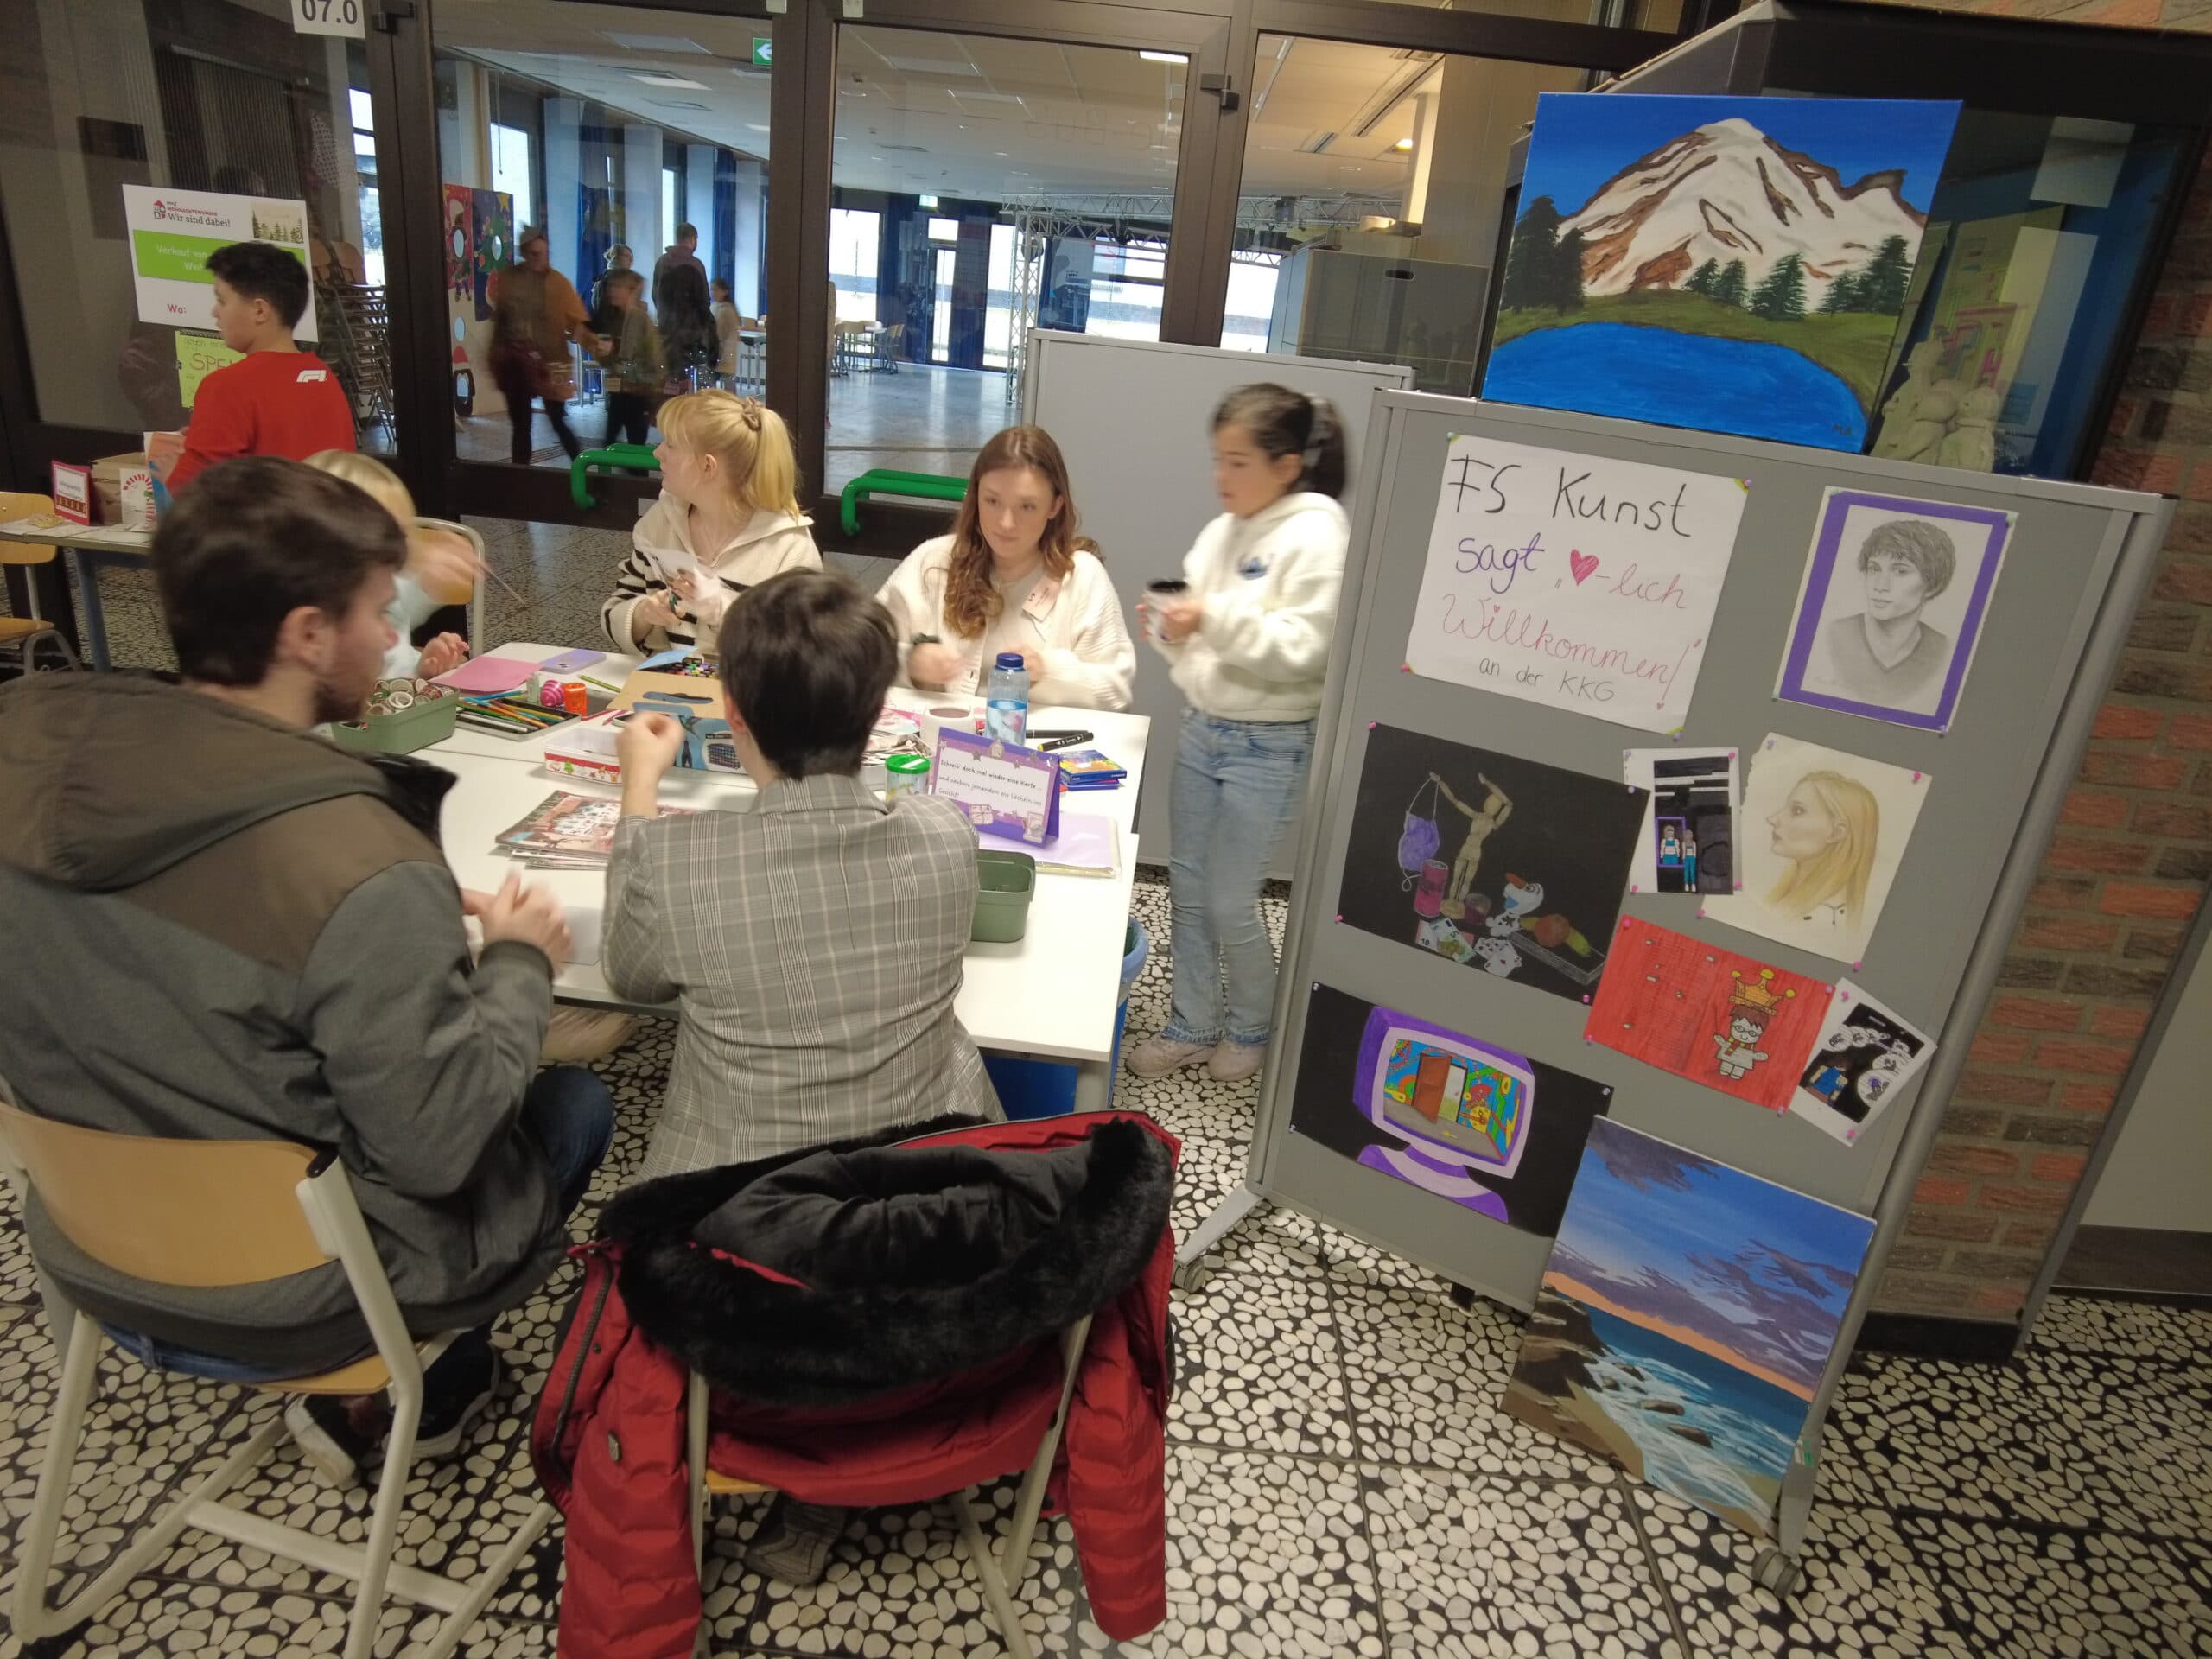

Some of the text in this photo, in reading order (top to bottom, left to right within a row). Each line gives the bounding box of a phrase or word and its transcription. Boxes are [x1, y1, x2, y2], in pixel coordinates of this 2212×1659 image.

[168, 213, 231, 227] Wir sind dabei!
[168, 304, 187, 314] Wo:
[1448, 454, 1691, 537] FS Kunst
[1479, 658, 1615, 702] an der KKG
[962, 764, 976, 773] doch
